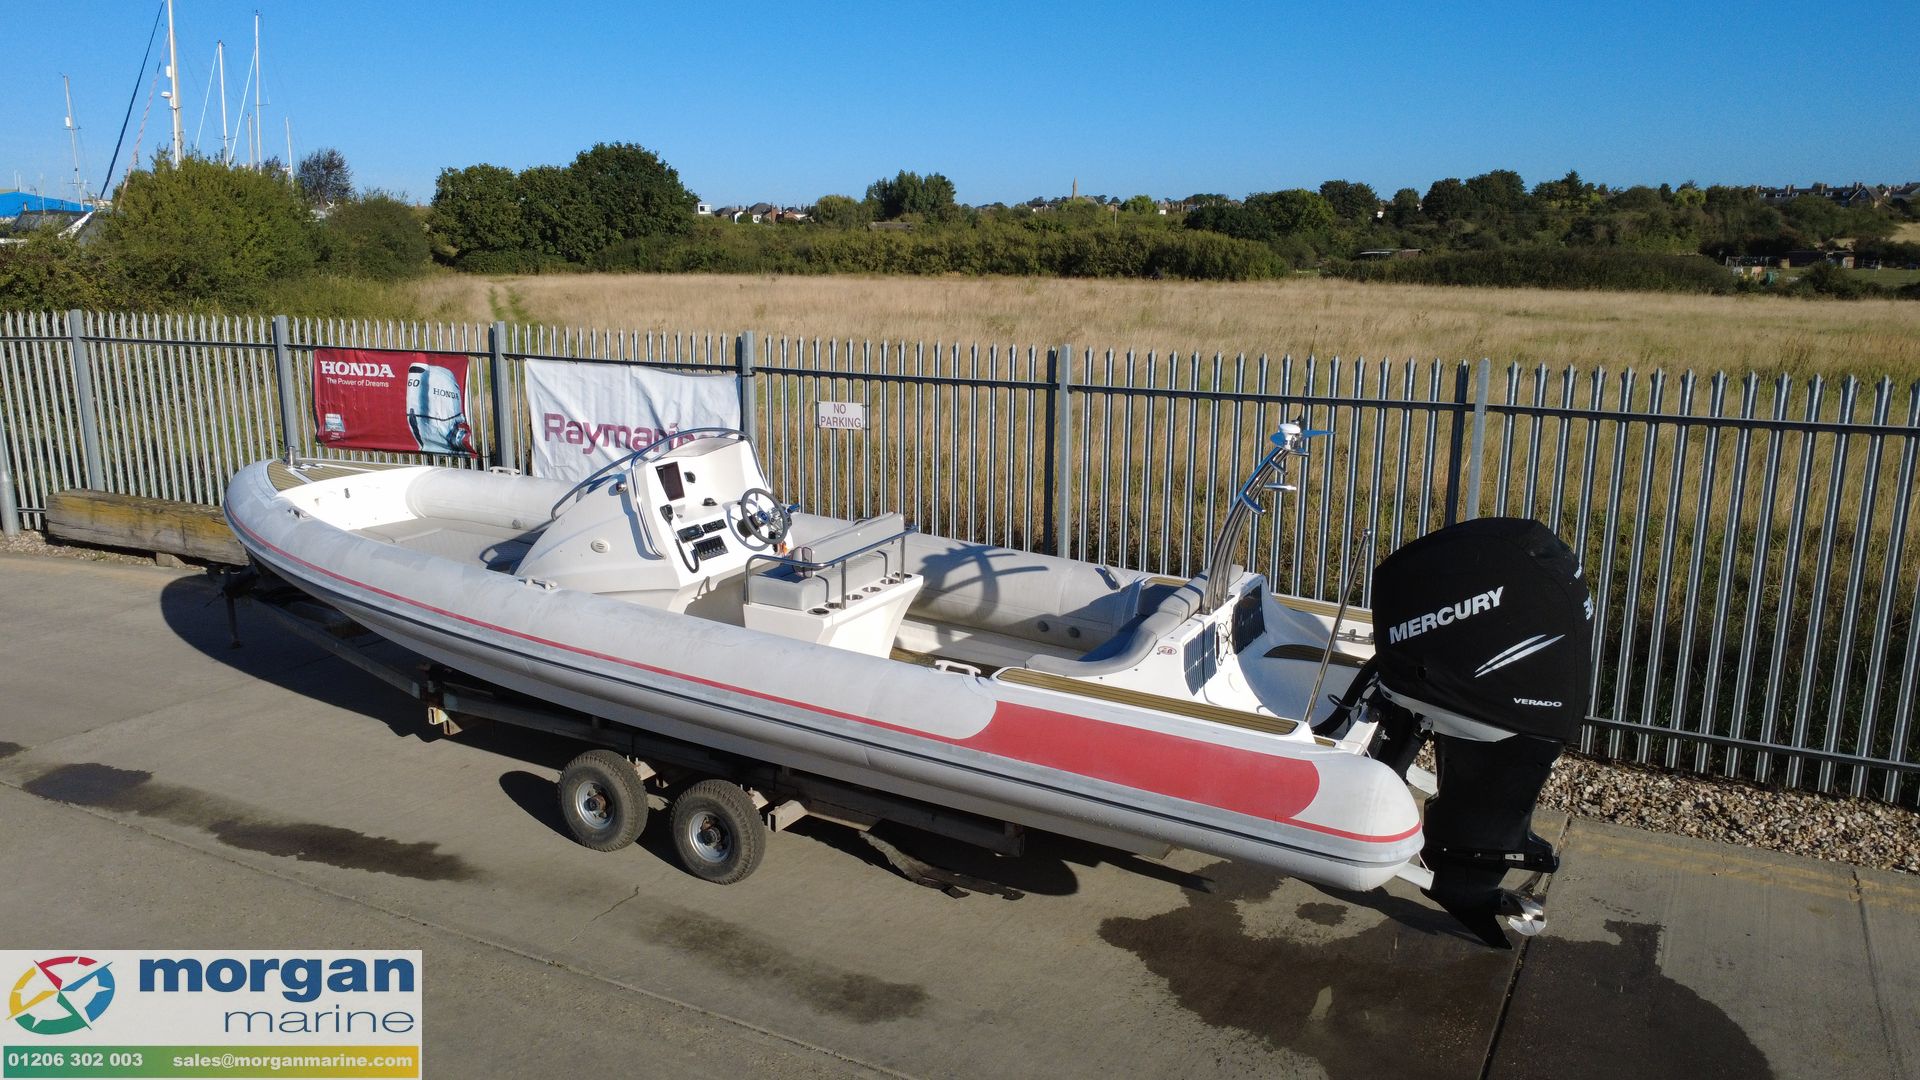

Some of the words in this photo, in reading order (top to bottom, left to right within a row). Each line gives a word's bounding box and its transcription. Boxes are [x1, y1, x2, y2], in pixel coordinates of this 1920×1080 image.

[320, 360, 395, 378] HONDA
[326, 377, 337, 385] The
[337, 378, 357, 386] Power
[357, 378, 365, 386] of
[365, 379, 390, 388] Dreams
[407, 378, 420, 388] 60
[433, 388, 459, 400] HONDA
[833, 403, 847, 415] NO
[820, 415, 862, 428] PARKING
[544, 412, 716, 455] Raymarin
[1389, 586, 1504, 645] MERCURY
[1513, 697, 1562, 708] VERADO
